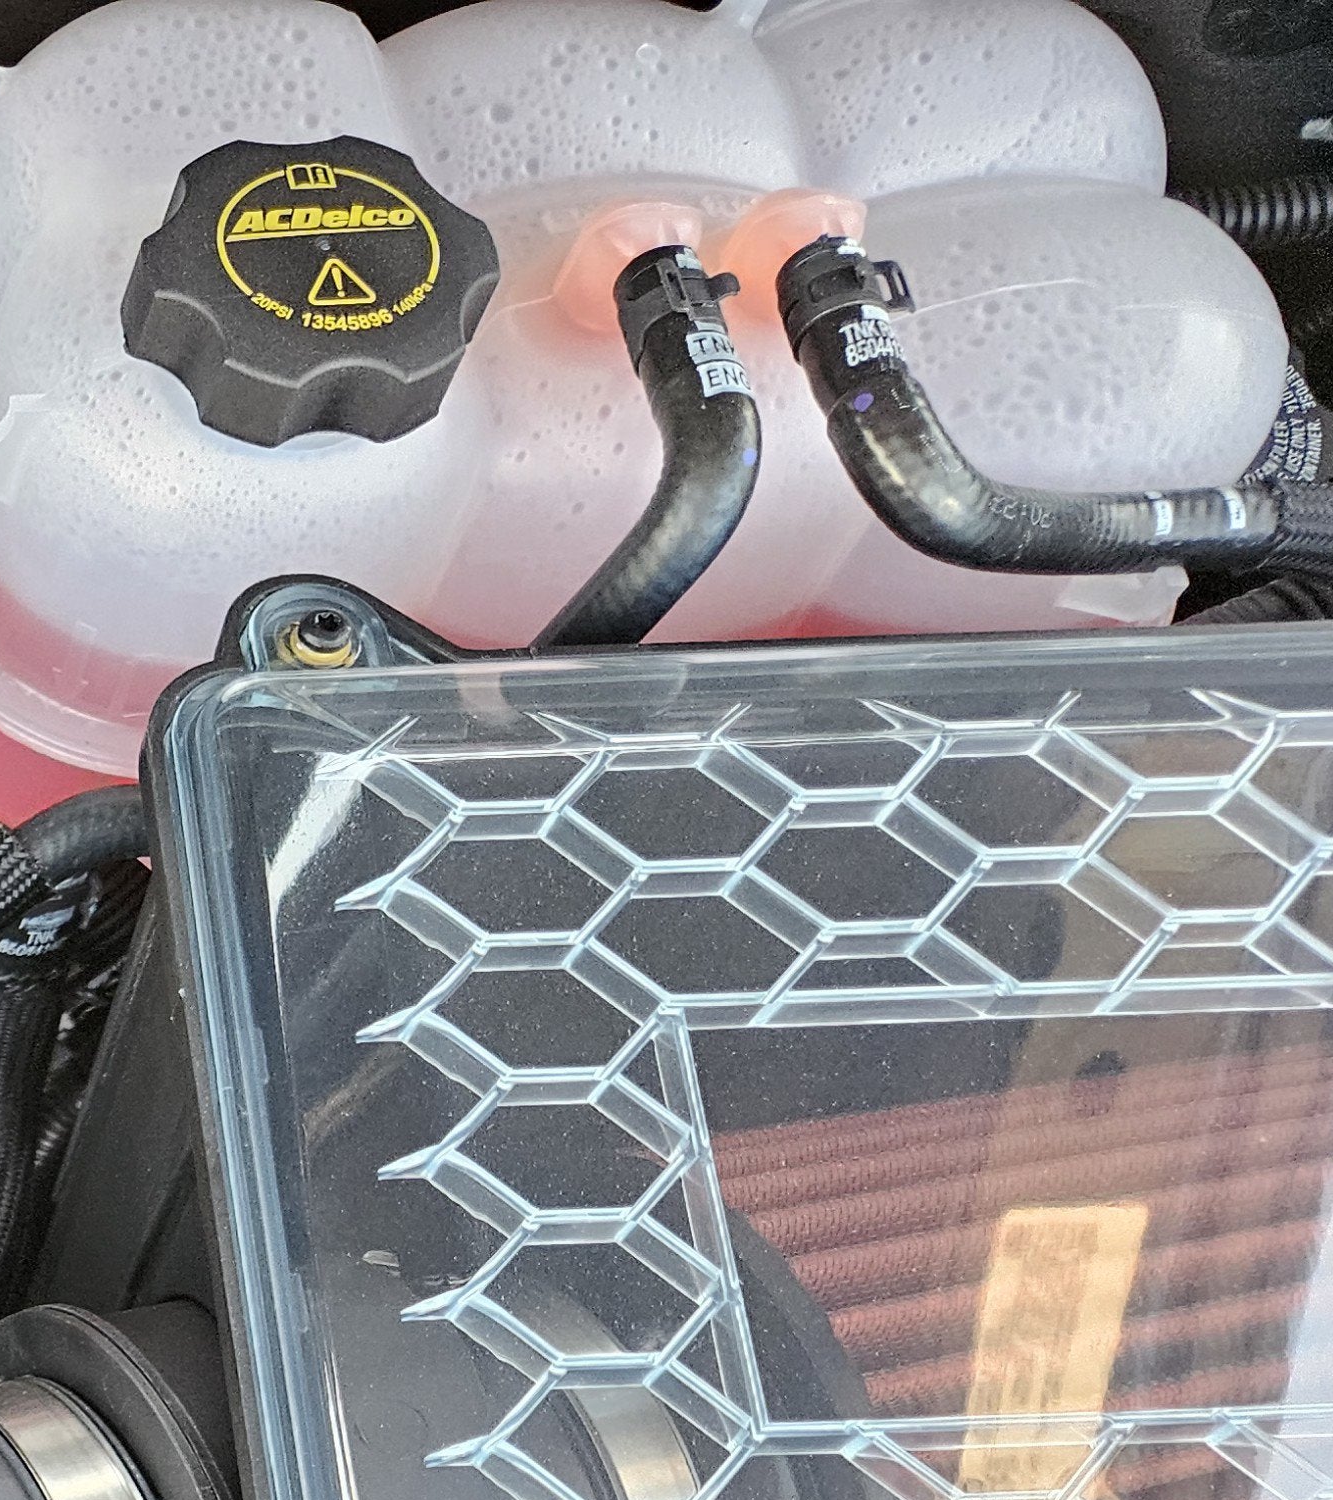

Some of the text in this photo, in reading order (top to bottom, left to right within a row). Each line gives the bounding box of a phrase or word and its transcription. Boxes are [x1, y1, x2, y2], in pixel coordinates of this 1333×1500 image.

[231, 202, 416, 234] ACDelco
[251, 292, 294, 320] 20PSI
[301, 308, 393, 331] 13545896
[838, 319, 880, 344] TNK
